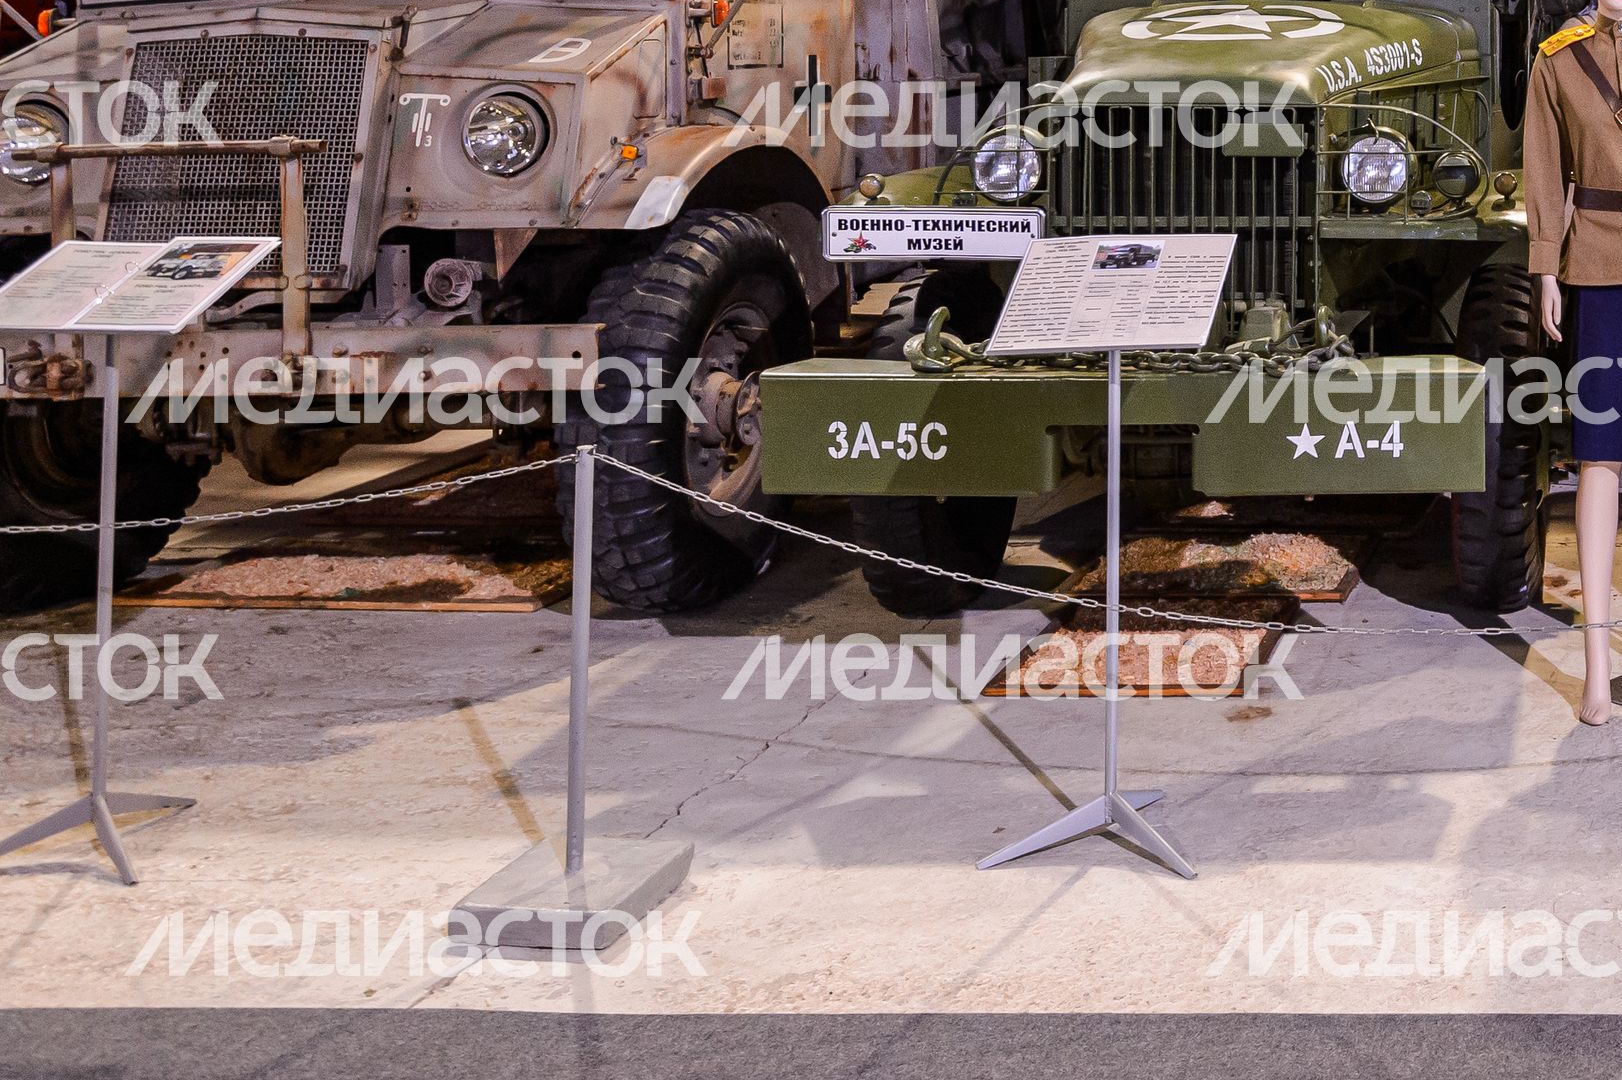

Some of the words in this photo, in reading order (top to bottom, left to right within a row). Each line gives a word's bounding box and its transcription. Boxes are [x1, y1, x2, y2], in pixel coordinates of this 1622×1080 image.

[1316, 56, 1363, 93] U.S.A.
[837, 218, 1031, 233] ВОЕННО-ТЕХНИЧЕСКИЙ
[907, 235, 964, 251] МУЗЕЙ
[1334, 420, 1404, 459] A-4
